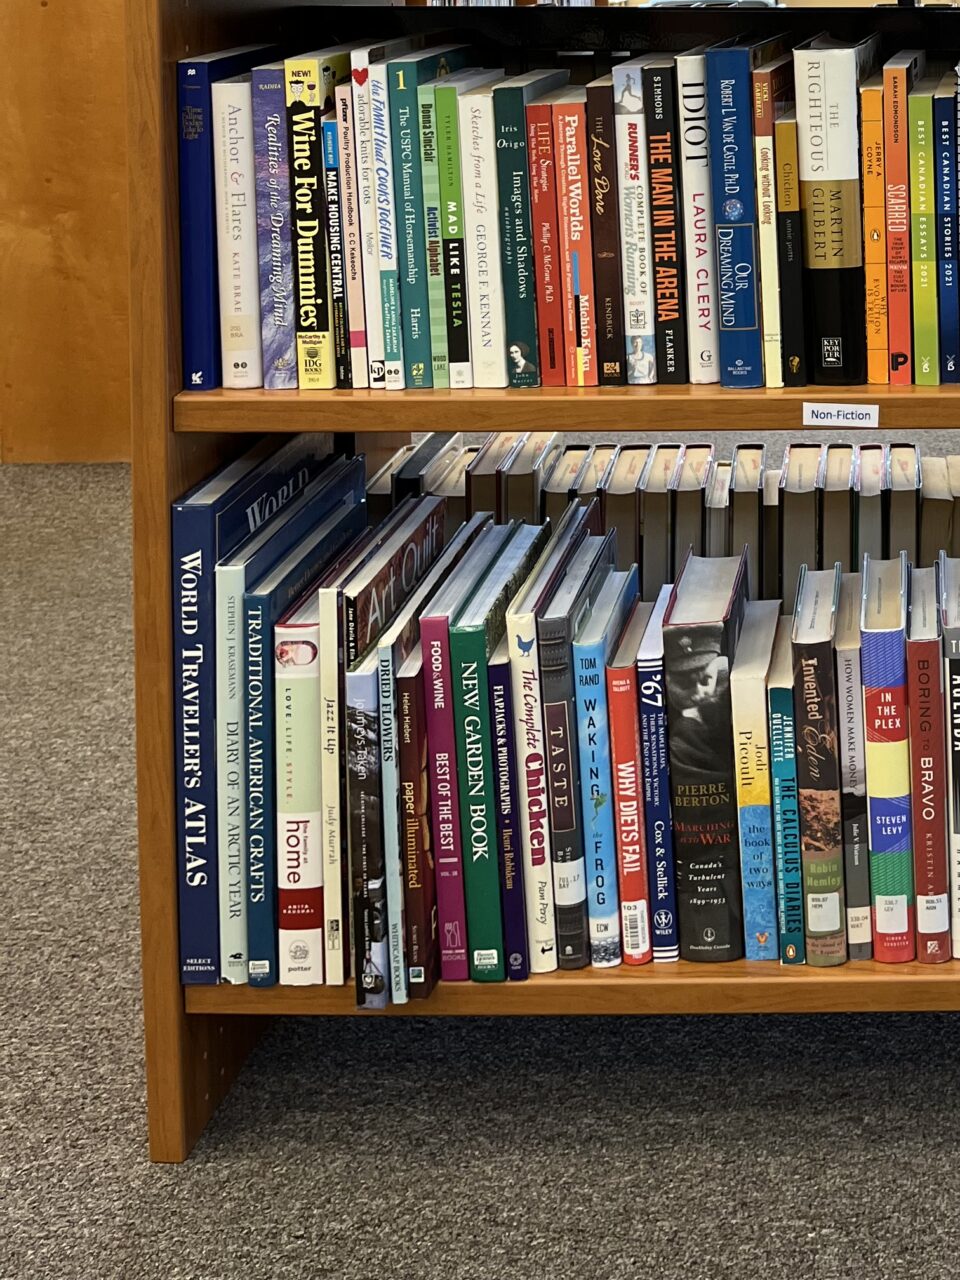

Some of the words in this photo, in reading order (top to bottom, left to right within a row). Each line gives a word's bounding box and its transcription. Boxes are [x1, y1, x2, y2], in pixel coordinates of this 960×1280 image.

[682, 82, 709, 169] IDIOT
[807, 60, 825, 173] RIGHTEOUS
[291, 109, 316, 171] Wine
[649, 131, 671, 164] THE
[295, 174, 318, 214] For
[326, 171, 338, 202] MAKE
[651, 167, 673, 204] MAN
[887, 184, 907, 232] SCARRED
[328, 204, 341, 251] HOUSING
[447, 201, 458, 234] MAD
[653, 208, 674, 225] IN
[692, 192, 708, 259] LAURA
[812, 187, 826, 261] GILBERT
[830, 189, 844, 258] MARTIN
[450, 243, 460, 275] LIKE
[654, 229, 676, 261] THE
[295, 219, 323, 328] Dummies
[331, 255, 344, 300] CENTRAL
[655, 266, 680, 322] ARENA
[451, 283, 462, 328] TESLA
[696, 269, 711, 332] CLERY
[811, 410, 871, 420] Non-Fiction
[178, 549, 203, 636] WORLD
[461, 661, 478, 710] NEW
[580, 658, 597, 669] TOM
[580, 674, 600, 687] RAND
[182, 644, 205, 788] TRAVELLER'S
[877, 706, 897, 716] THE
[881, 693, 893, 703] IN
[874, 718, 901, 730] PLEX
[463, 715, 484, 799] GARDEN
[618, 761, 635, 794] WHY
[675, 792, 730, 807] BERTON
[678, 783, 726, 796] PIERRE
[921, 757, 935, 820] BRAVO
[184, 797, 208, 888] ATLAS
[469, 804, 489, 863] BOOK
[619, 798, 638, 845] DIETS
[876, 815, 907, 826] STEVEN
[882, 825, 903, 835] LEVY
[622, 846, 641, 876] FAIL
